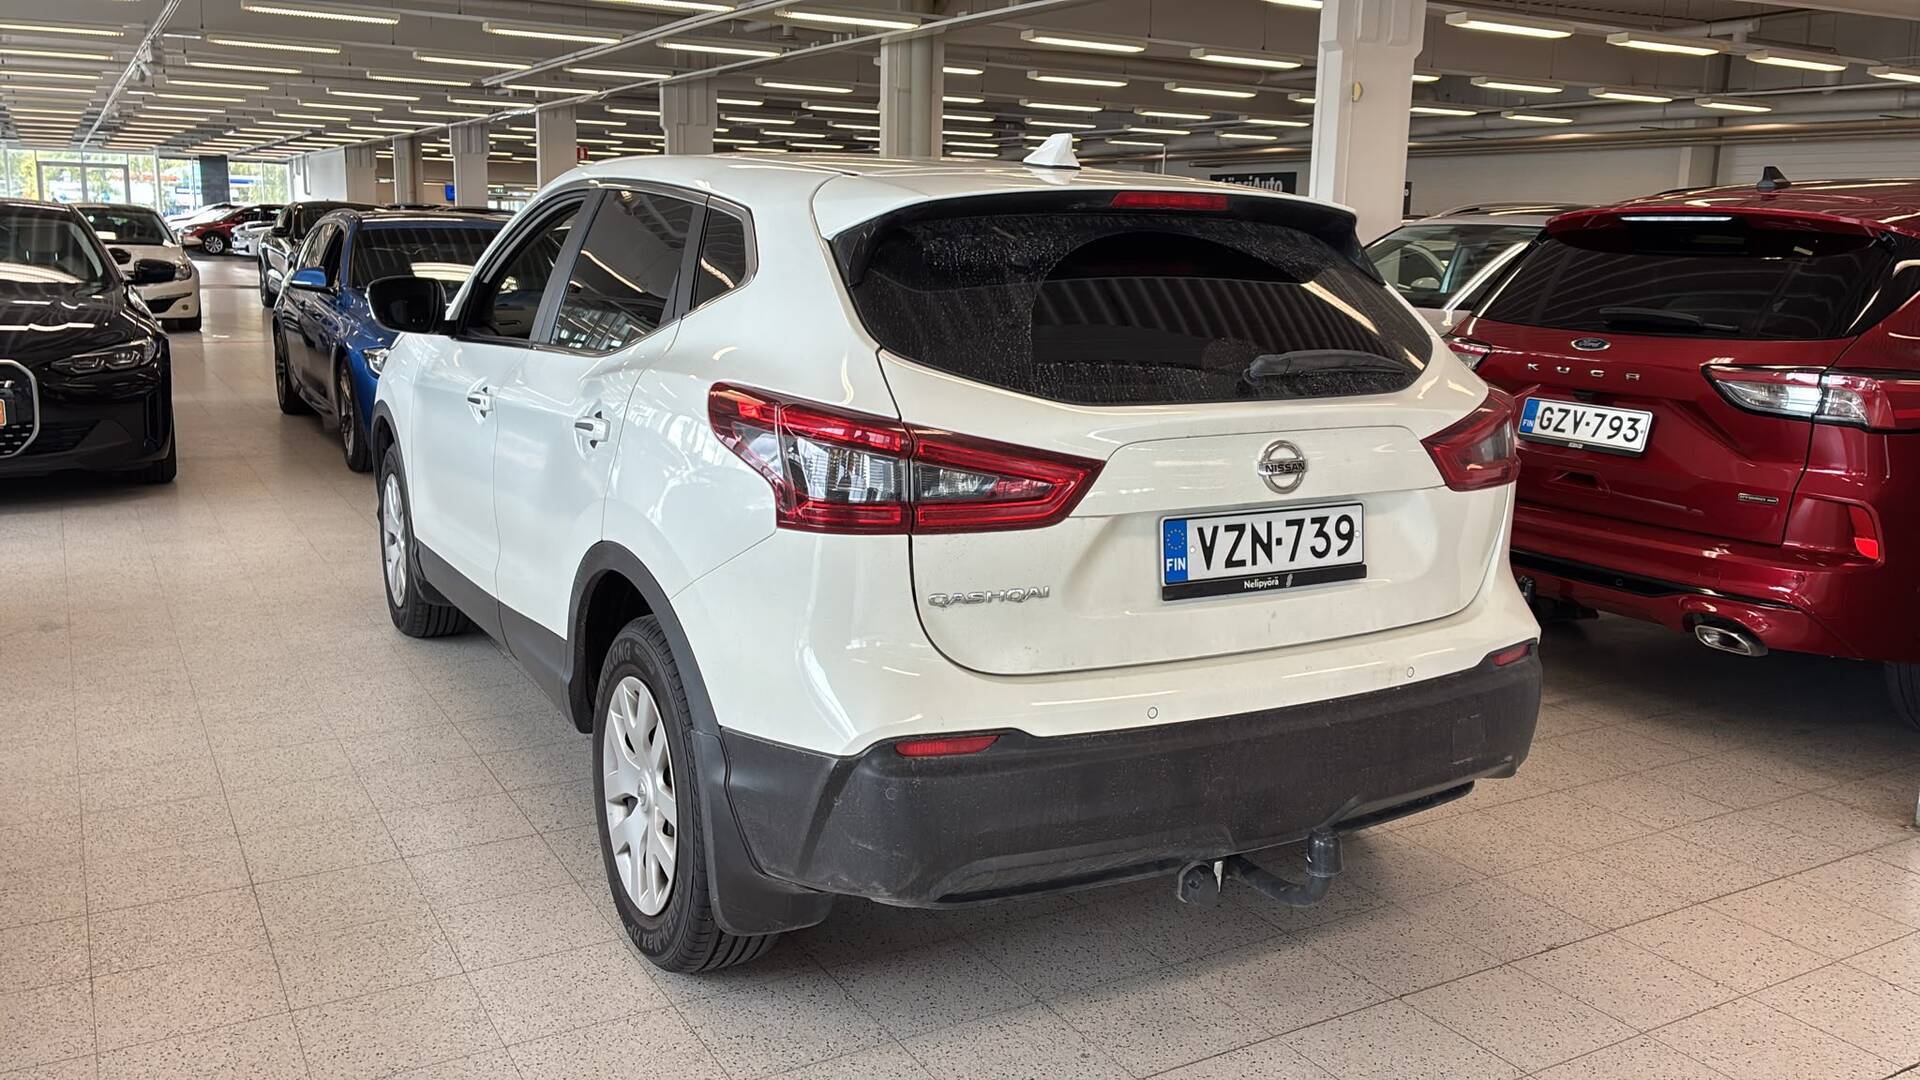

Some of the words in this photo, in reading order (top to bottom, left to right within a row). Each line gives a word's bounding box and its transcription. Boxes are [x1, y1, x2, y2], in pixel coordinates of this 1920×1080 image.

[1521, 418, 1534, 427] FIN
[1265, 462, 1305, 473] NISSAN
[1166, 557, 1186, 572] FIN
[1244, 576, 1279, 589] Nelipyörä
[928, 586, 1050, 608] QASHQAI
